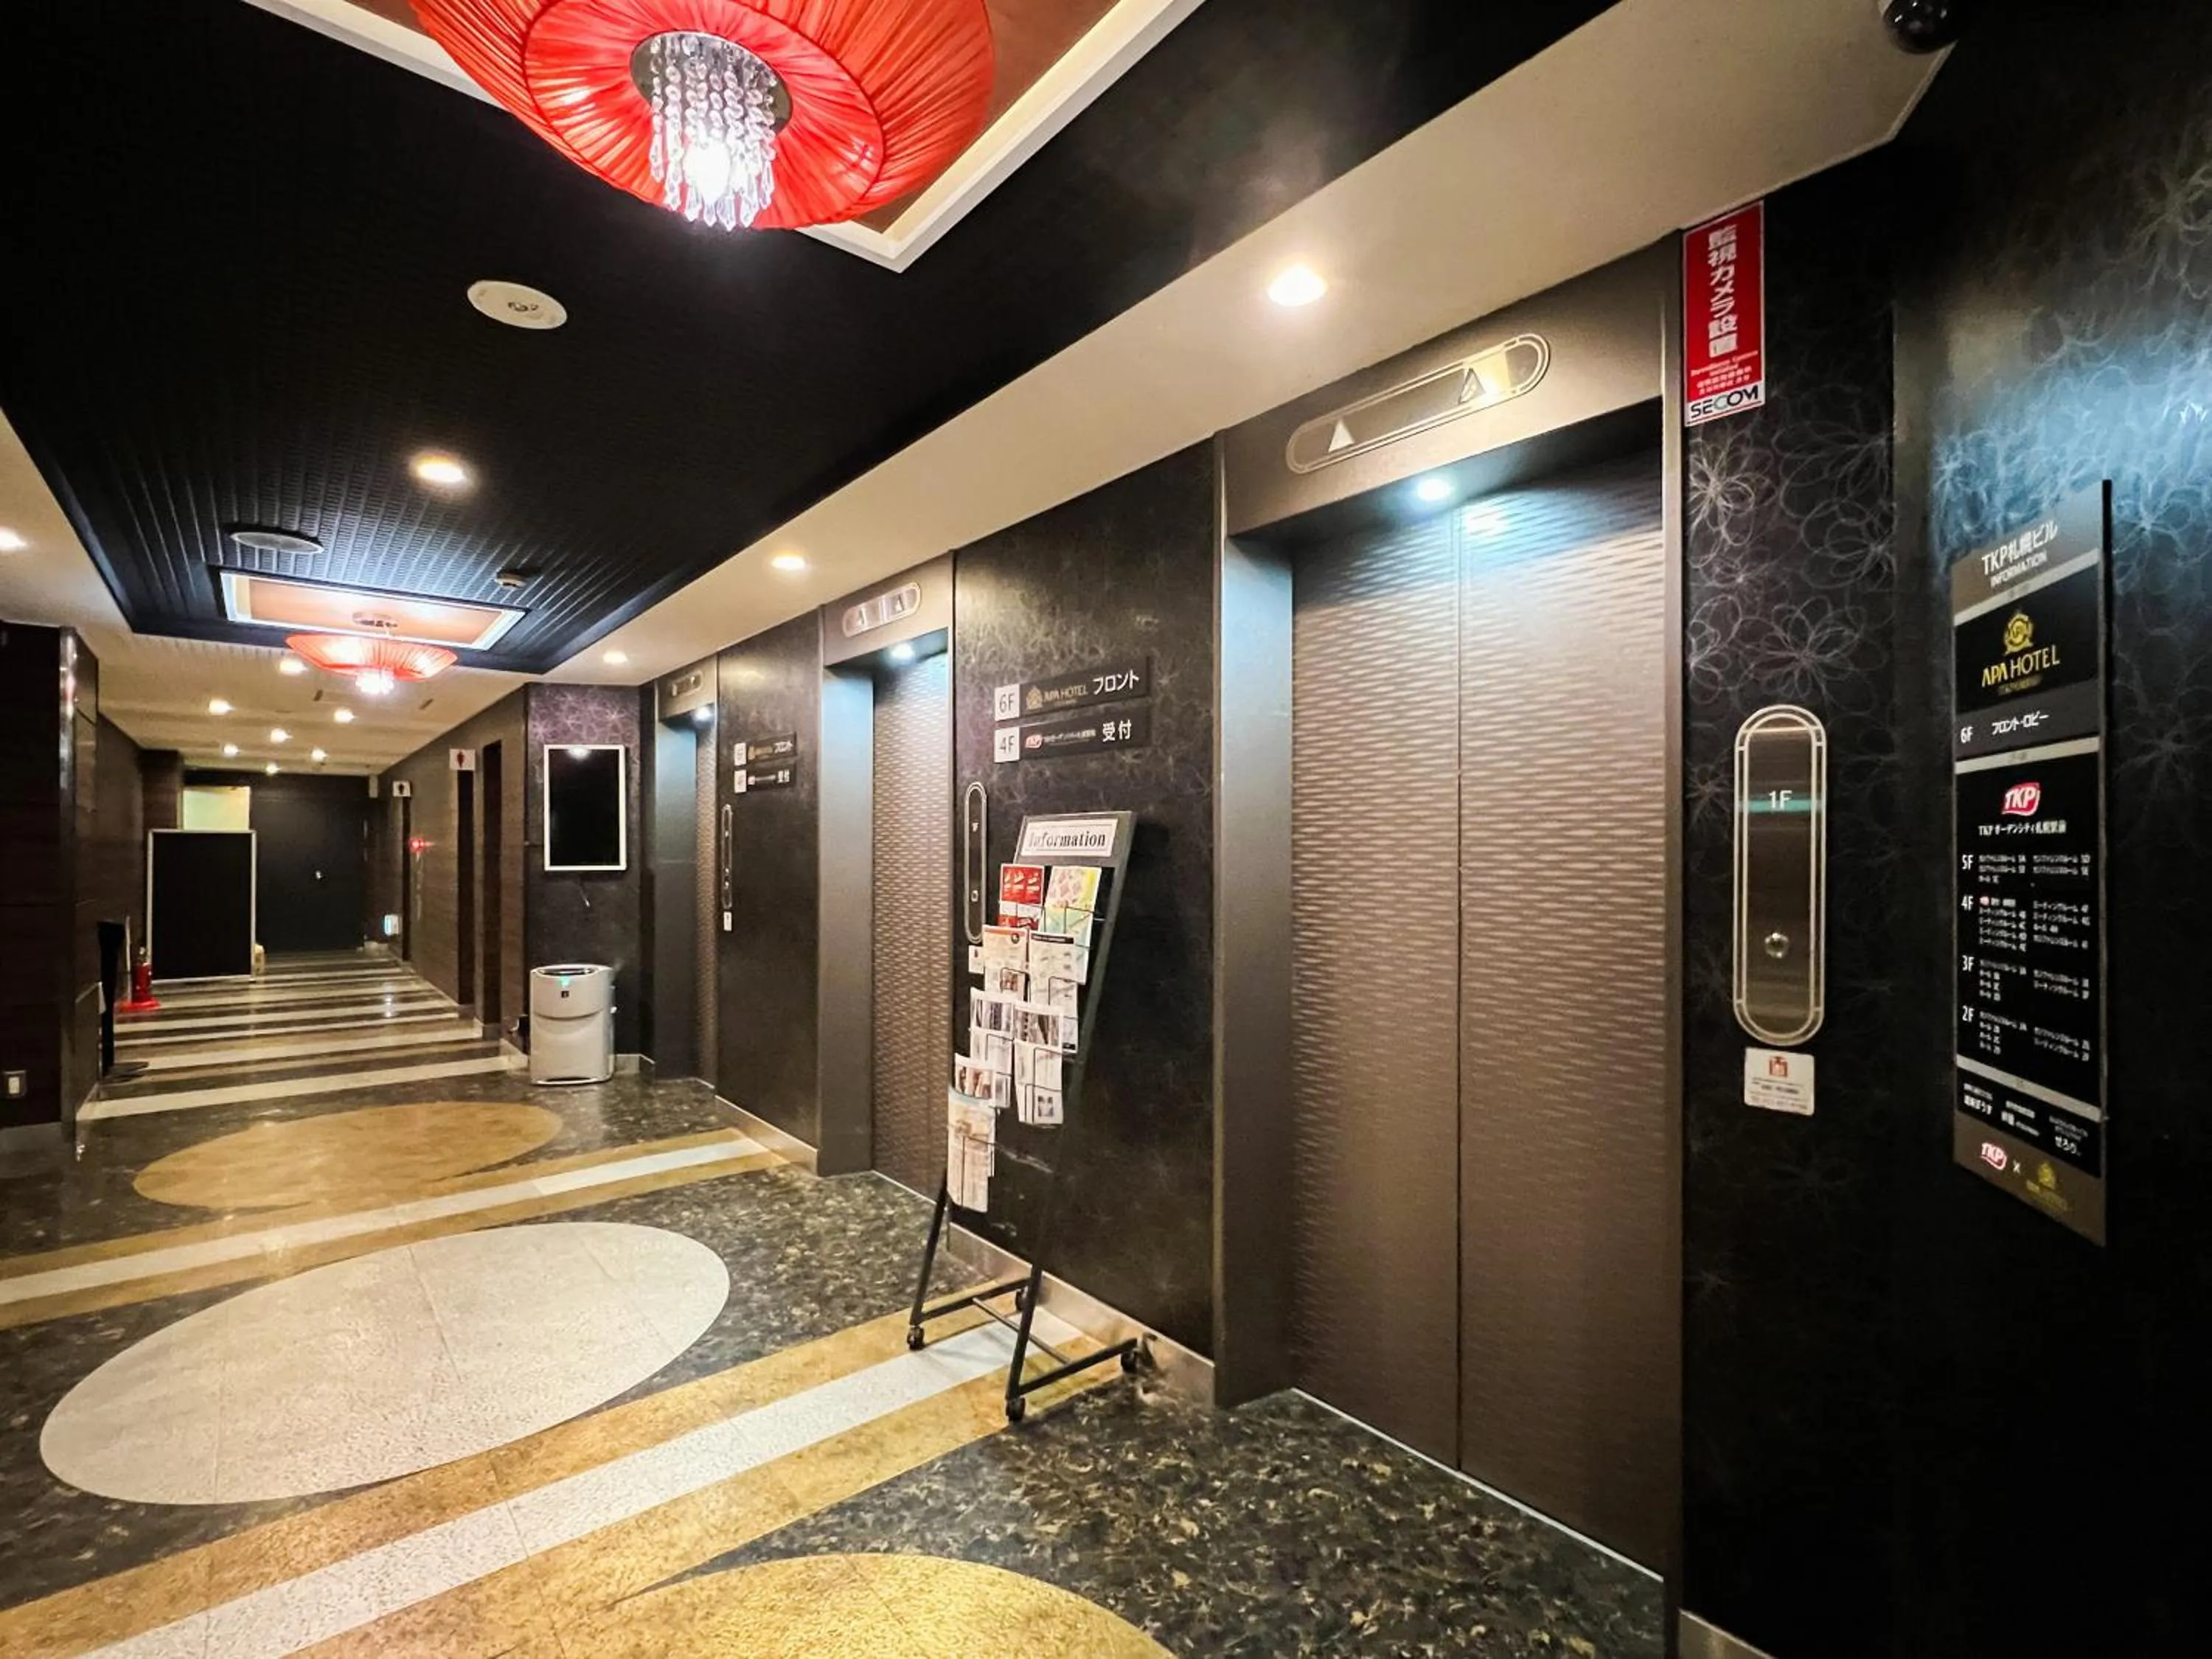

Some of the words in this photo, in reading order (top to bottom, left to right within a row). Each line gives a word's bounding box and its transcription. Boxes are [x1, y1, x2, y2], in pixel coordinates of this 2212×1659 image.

[1691, 385, 1759, 419] SECOM
[1981, 662, 2008, 688] APA
[2010, 644, 2060, 679] HOTEL
[1093, 669, 1140, 695] フロント
[1061, 684, 1088, 700] HOTEL
[998, 693, 1015, 715] 6F
[1102, 719, 1133, 742] 受付
[1961, 726, 1974, 744] 6F
[998, 735, 1015, 754] 4F
[1768, 789, 1793, 810] 1F
[2004, 785, 2037, 811] TKP
[1028, 830, 1106, 848] Information
[1961, 854, 1974, 871] 5F
[1961, 894, 1974, 912] 4F
[1961, 955, 1975, 972] 3F
[1961, 1005, 1975, 1022] 2F
